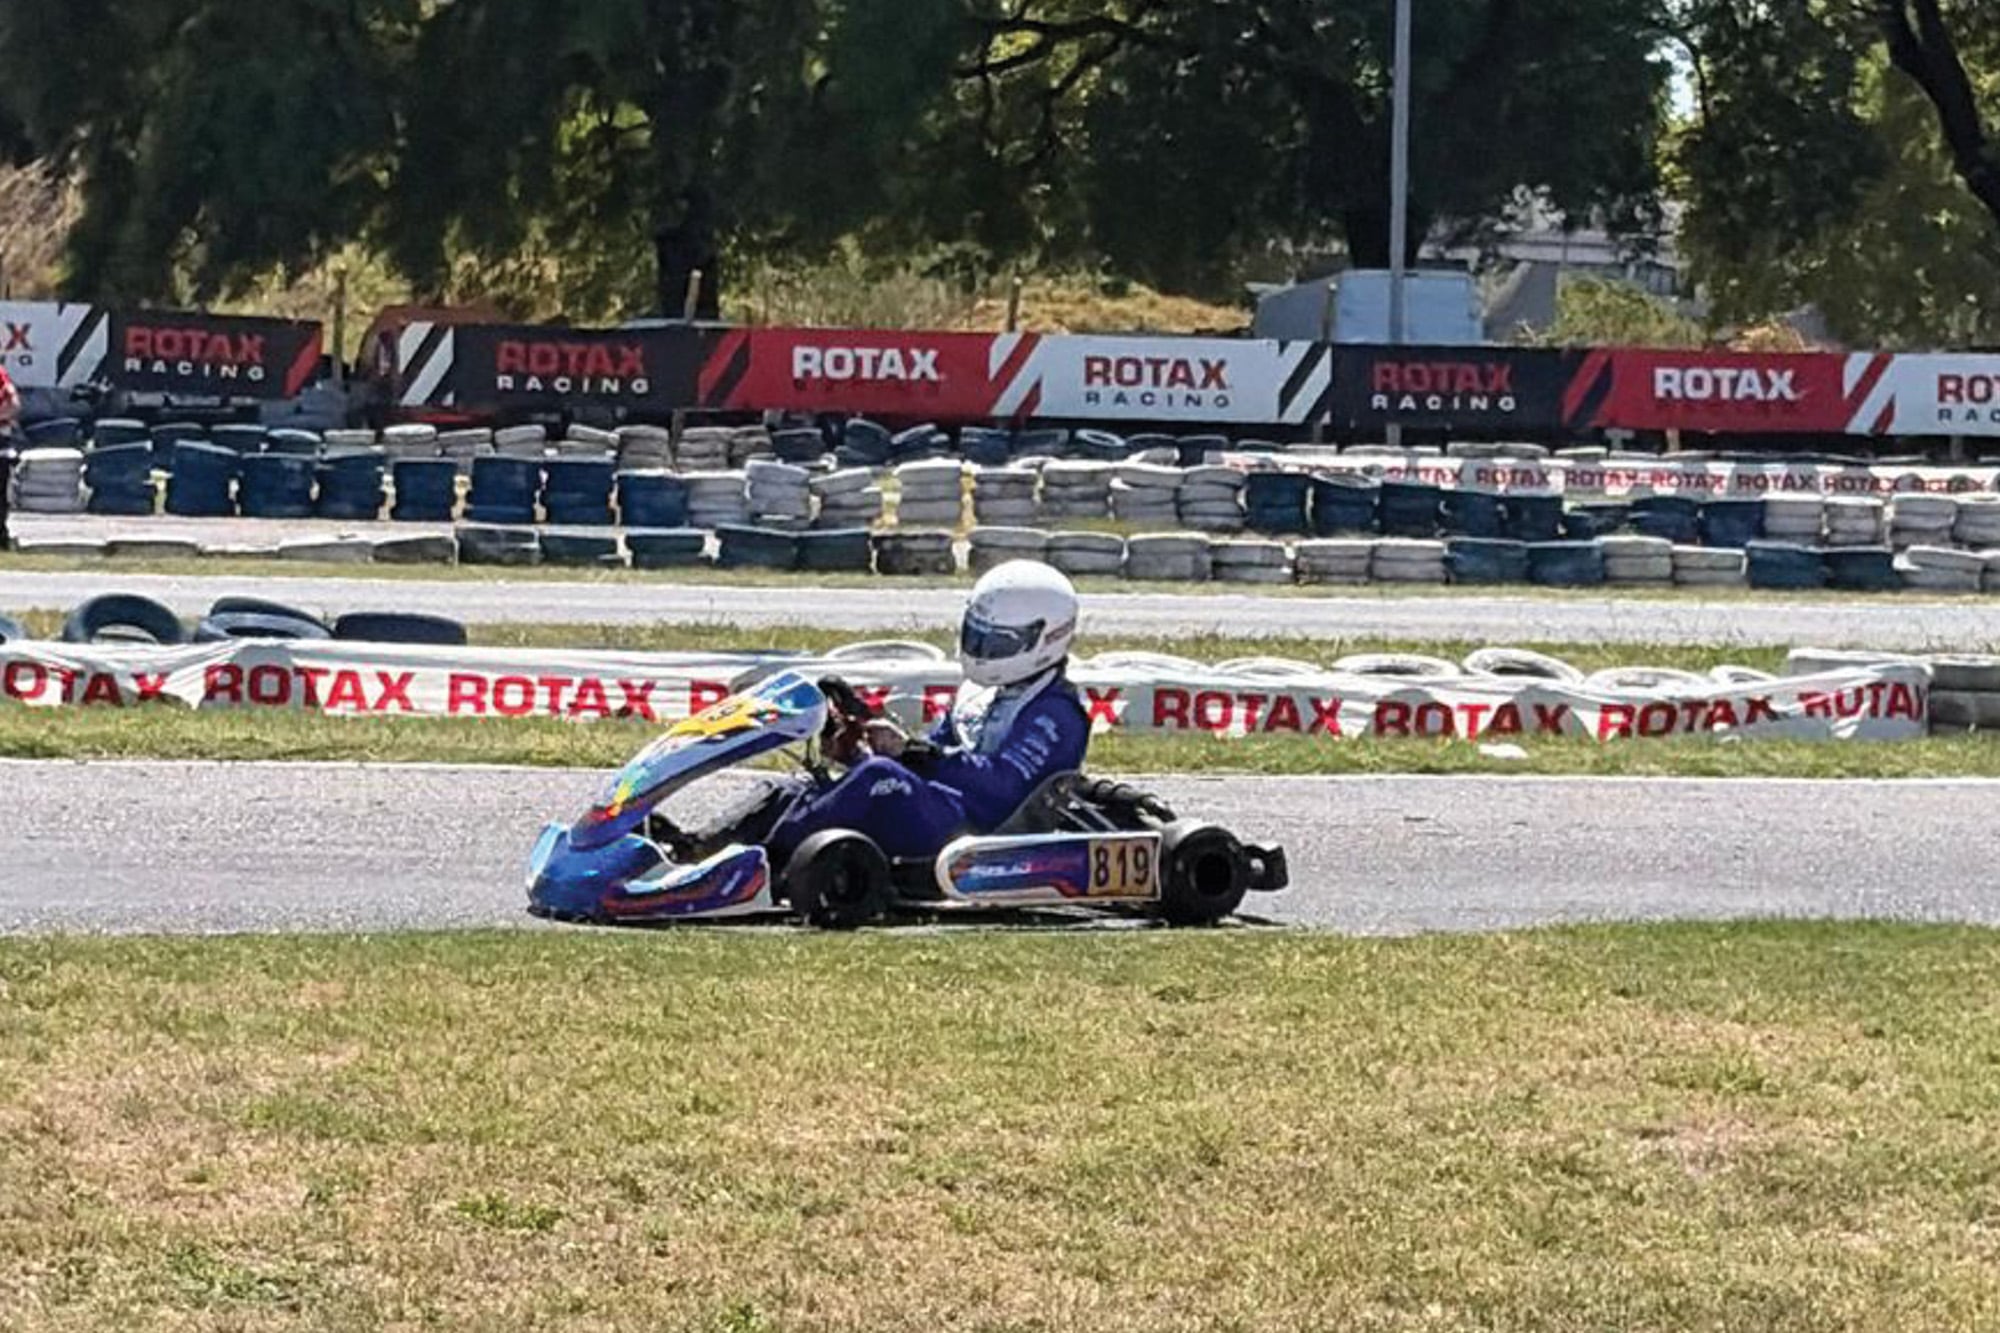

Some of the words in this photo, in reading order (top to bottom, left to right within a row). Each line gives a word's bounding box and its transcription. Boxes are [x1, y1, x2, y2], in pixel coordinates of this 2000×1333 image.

[125, 326, 264, 363] ROTAX
[496, 340, 645, 376] ROTAX
[125, 358, 264, 381] RACING
[792, 346, 940, 381] ROTAX
[1084, 355, 1227, 390] ROTAX
[1373, 362, 1512, 392] ROTAX
[497, 376, 649, 394] RACING
[1086, 391, 1230, 408] RACING
[1654, 367, 1796, 401] ROTAX
[1372, 394, 1516, 411] RACING
[1476, 468, 1549, 486] ROTAX
[1565, 469, 1638, 487] ROTAX
[1650, 469, 1724, 488] ROTAX
[1737, 473, 1813, 489] ROTAX
[1824, 474, 1900, 491] ROTAX
[203, 663, 415, 711] ROTAX
[448, 673, 657, 722] ROTAX
[1153, 687, 1343, 737] ROTAX
[1374, 701, 1570, 742] ROTAX
[1598, 695, 1780, 742] ROTAX
[1094, 847, 1149, 887] 819
